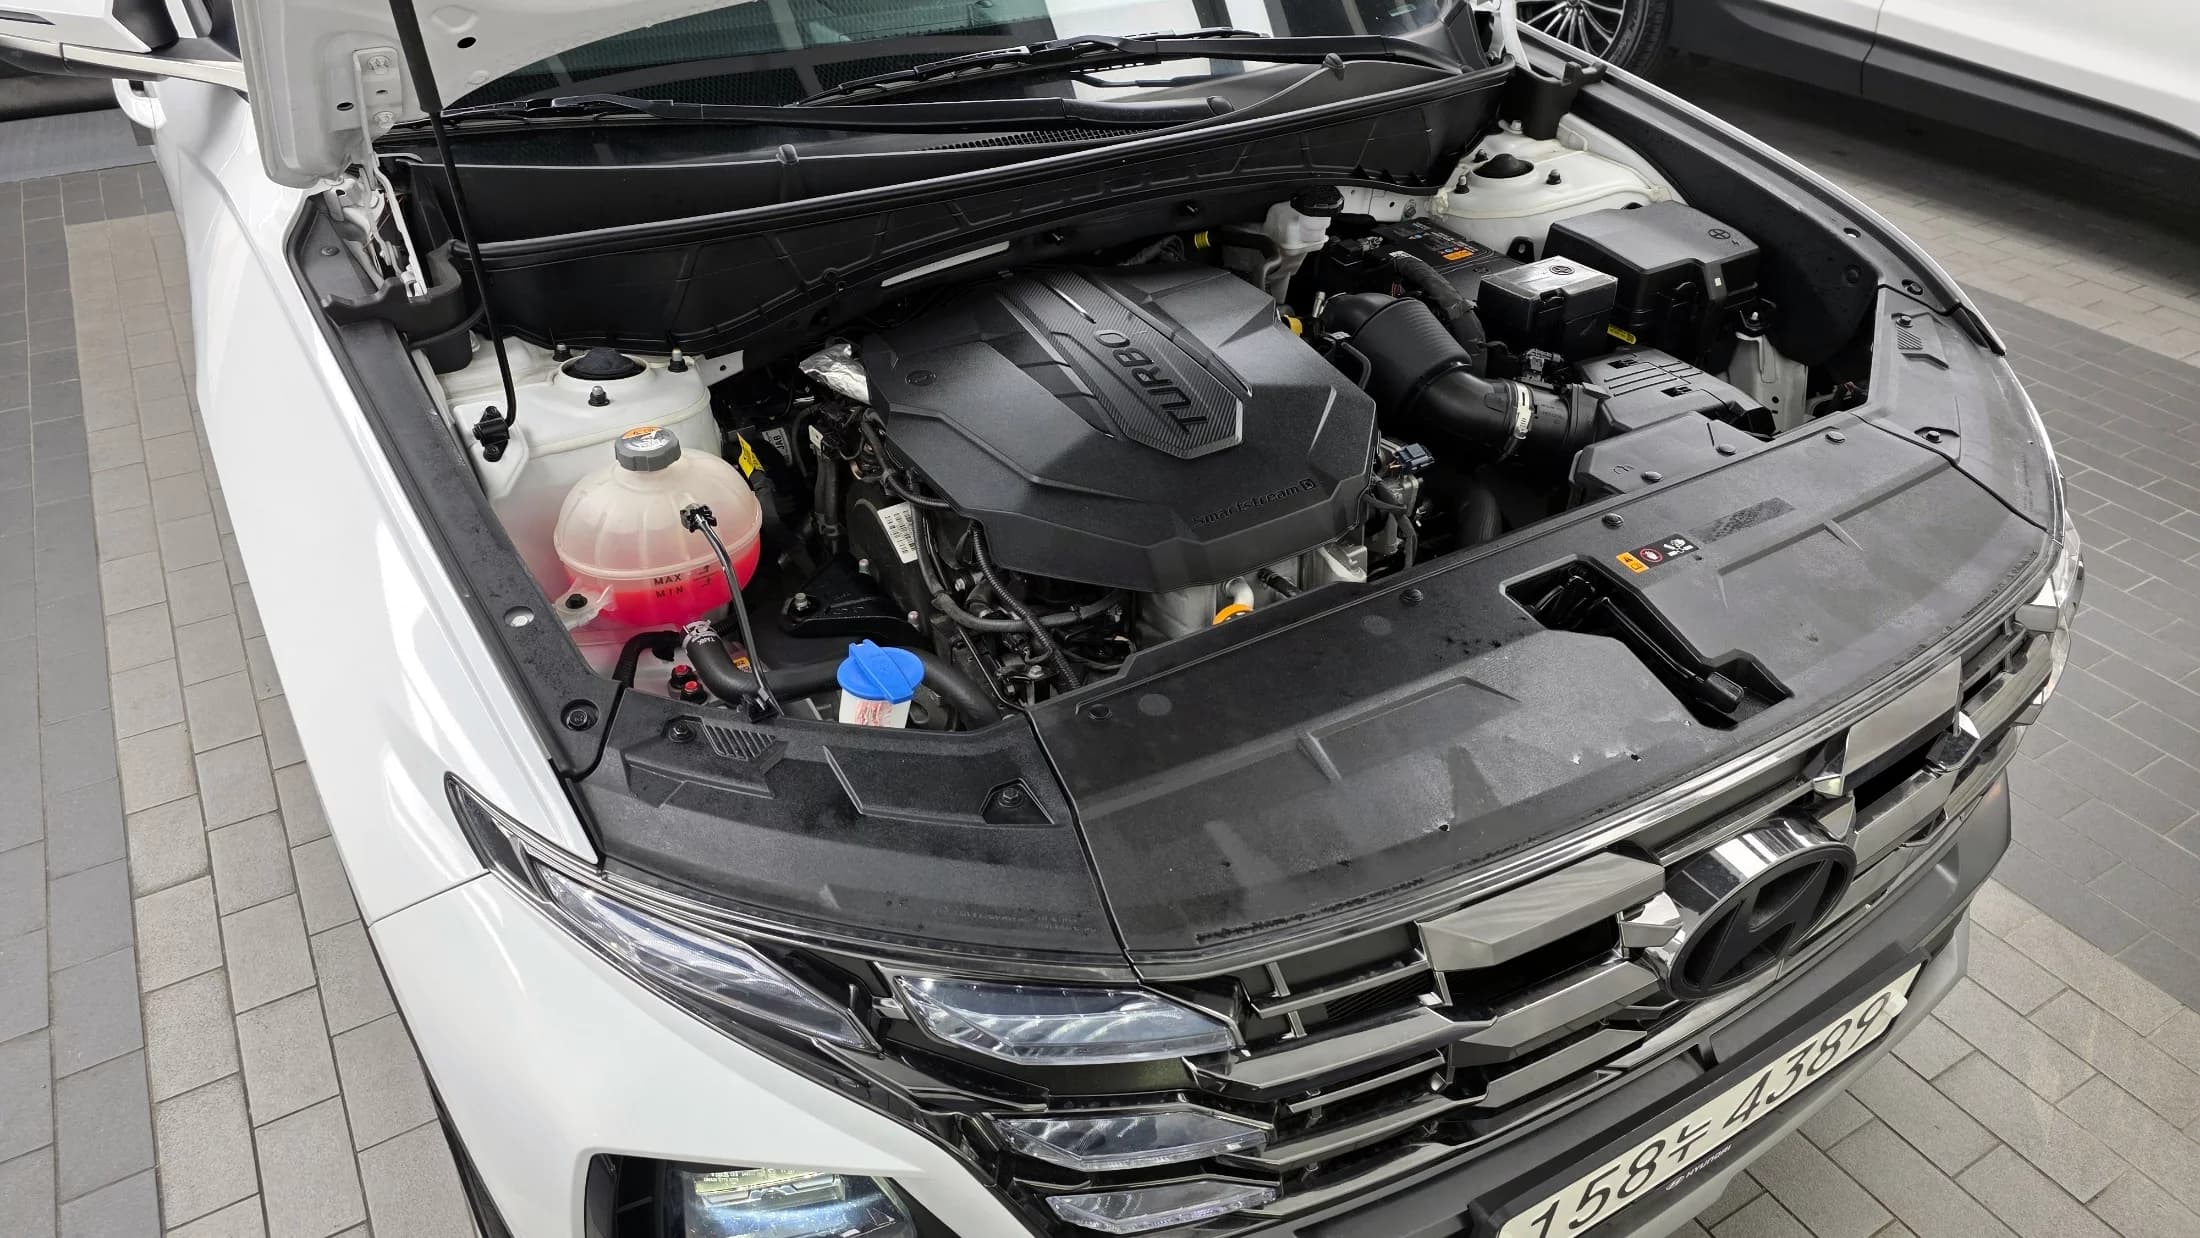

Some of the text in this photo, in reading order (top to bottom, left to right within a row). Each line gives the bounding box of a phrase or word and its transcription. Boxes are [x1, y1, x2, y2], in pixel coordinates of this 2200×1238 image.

[1094, 329, 1209, 434] TURBO
[1192, 486, 1301, 527] Smartstream
[654, 574, 682, 585] MAX
[656, 586, 683, 598] MIN
[1531, 991, 1891, 1238] 158누 4389
[1686, 1143, 1732, 1178] HYUNDAI
